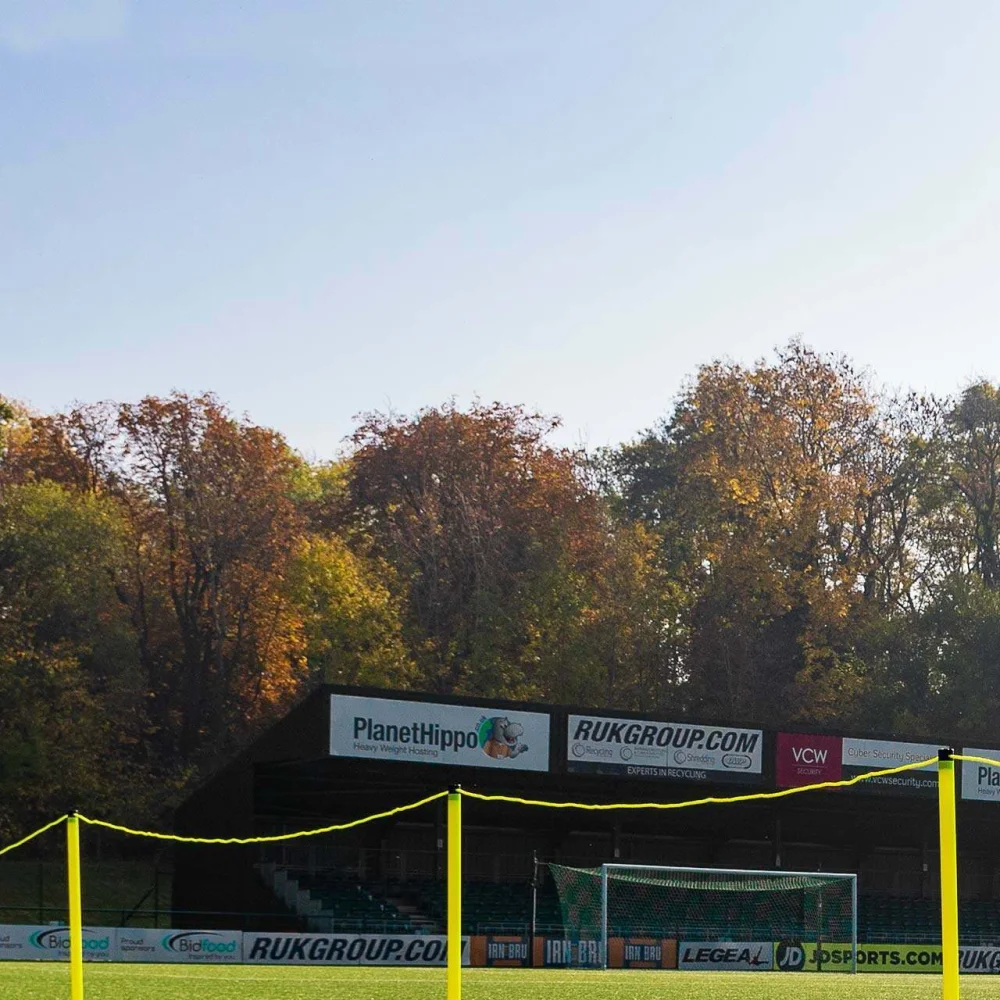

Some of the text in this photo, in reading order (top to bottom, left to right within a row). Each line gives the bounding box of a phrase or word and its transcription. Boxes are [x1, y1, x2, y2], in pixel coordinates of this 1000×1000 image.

[353, 716, 478, 752] PlanetHippo
[573, 719, 760, 753] RUKGROUP.COM
[353, 742, 439, 758] Heavy Weight Hosting
[792, 747, 828, 764] VCW
[847, 747, 870, 759] Cyber
[873, 749, 904, 762] Security
[627, 766, 707, 779] EXPERTS IN RECYCLING
[797, 768, 822, 776] SECURITY
[978, 787, 995, 796] Heavy
[49, 934, 109, 950] Bidood
[179, 938, 236, 952] Bidfood
[488, 943, 527, 959] IRN BRU
[546, 940, 571, 964] IRN
[625, 945, 661, 961] IRN BRU
[780, 946, 803, 966] JD
[809, 948, 943, 967] JDSPORTS.COM
